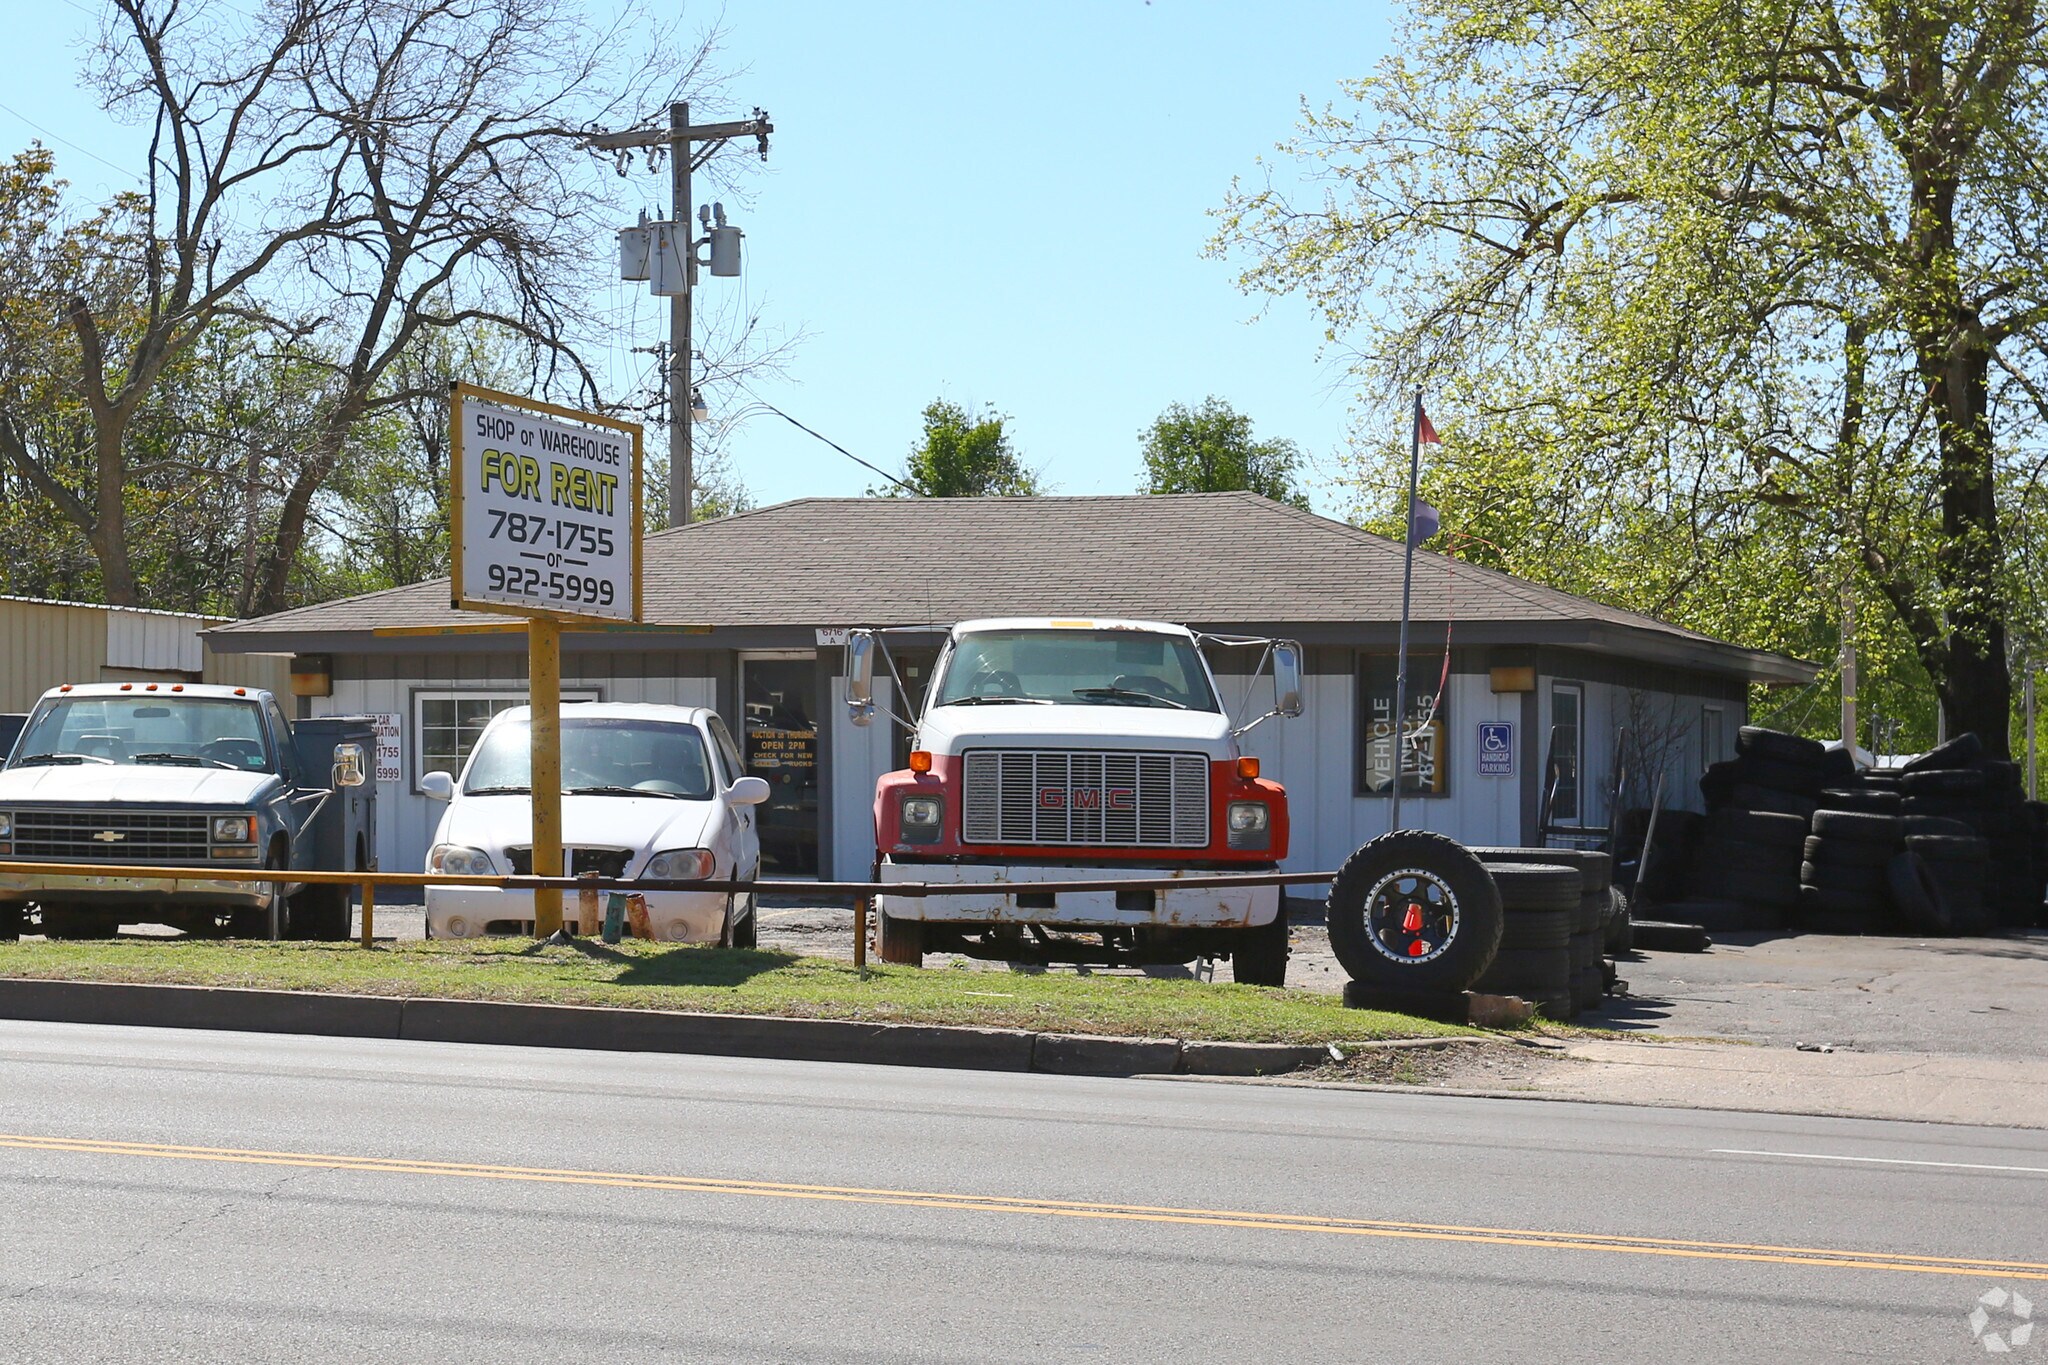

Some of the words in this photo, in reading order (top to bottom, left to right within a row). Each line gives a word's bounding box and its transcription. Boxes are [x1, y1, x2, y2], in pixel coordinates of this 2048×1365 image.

[476, 414, 515, 442] SHOP
[520, 428, 534, 447] or
[539, 428, 620, 466] WAREHOUSE
[481, 448, 542, 502] FOR
[550, 461, 618, 517] RENT
[488, 509, 613, 557] 787-1755
[488, 564, 614, 606] 922-5999
[378, 715, 390, 725] CAR
[761, 741, 784, 750] OPEN
[788, 741, 806, 750] 2PM
[1374, 698, 1391, 785] VEHICLE
[1481, 753, 1510, 762] HANDICAP
[1481, 763, 1510, 773] PARKING
[1040, 787, 1134, 810] GMC
